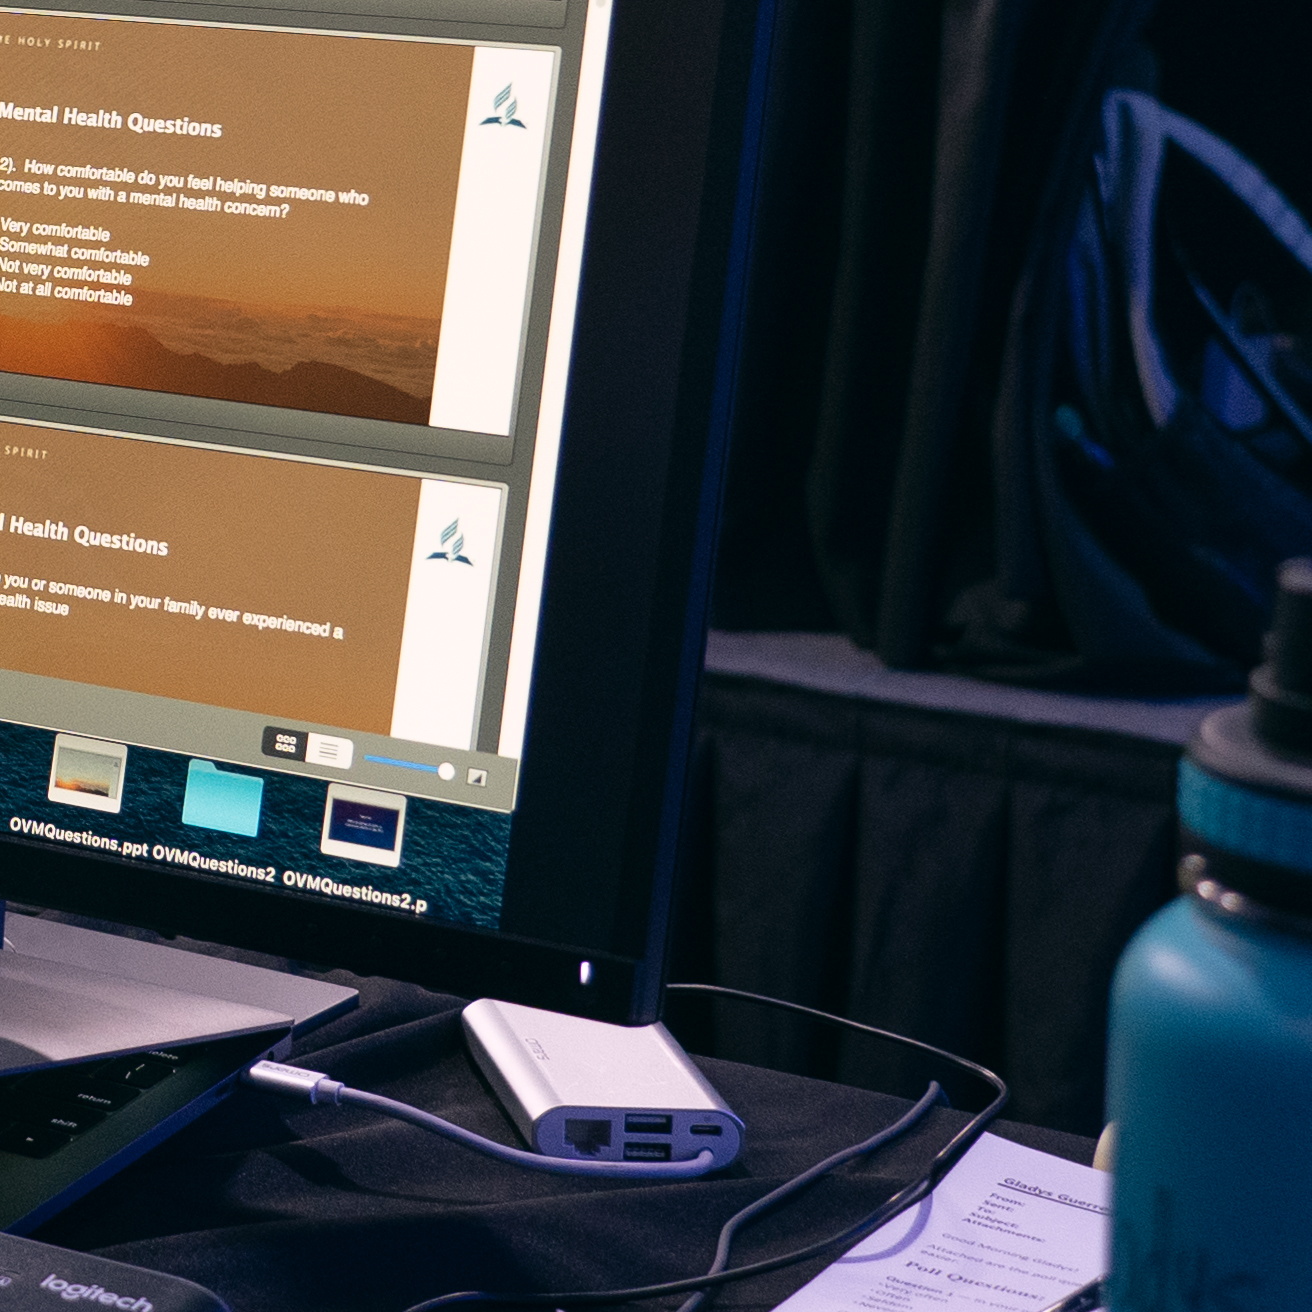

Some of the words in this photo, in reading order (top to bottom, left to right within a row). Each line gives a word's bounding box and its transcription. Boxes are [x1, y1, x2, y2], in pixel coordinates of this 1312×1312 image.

[63, 107, 122, 128] Health
[127, 112, 221, 137] Questions
[23, 158, 55, 175] How
[56, 164, 135, 183] comfortable
[136, 169, 156, 185] do
[157, 174, 184, 189] you
[186, 173, 213, 190] feel
[215, 176, 266, 199] helping
[269, 184, 335, 202] someone
[337, 188, 369, 205] who
[42, 180, 57, 196] to
[58, 184, 84, 200] you
[86, 185, 114, 201] with
[116, 190, 127, 203] a
[129, 191, 176, 207] mental
[178, 193, 221, 211] health
[223, 201, 289, 218] concern?
[0, 216, 30, 236] Very
[31, 222, 110, 241] comfortable
[70, 247, 149, 266] comfortable
[21, 262, 52, 279] very
[53, 265, 131, 285] comfortable
[18, 280, 34, 295] at
[34, 281, 52, 297] all
[53, 285, 132, 305] comfortable
[9, 817, 148, 856] OVMQuestions.ppt
[152, 845, 275, 881] OVMQuestions2
[283, 870, 427, 912] OVMQuestions2.p
[1003, 1177, 1053, 1197] Gladys
[40, 1275, 154, 1312] logitech
